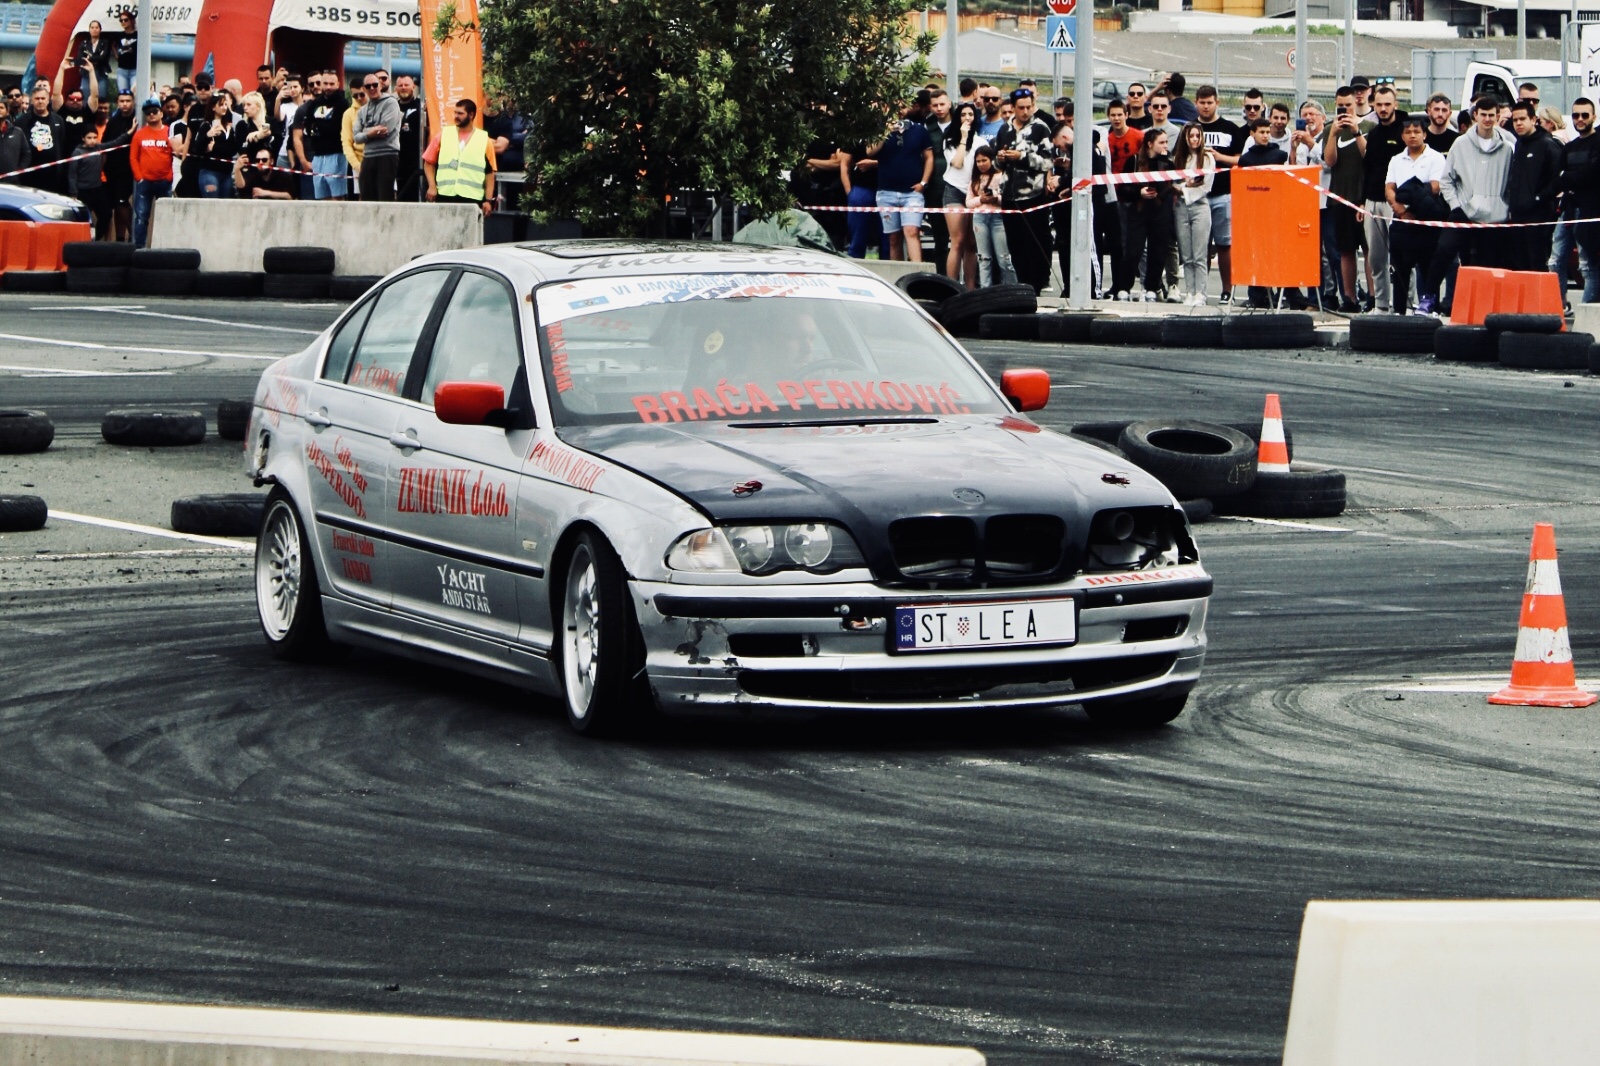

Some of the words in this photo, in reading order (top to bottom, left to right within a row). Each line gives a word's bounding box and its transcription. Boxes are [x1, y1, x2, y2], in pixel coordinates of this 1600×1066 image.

[151, 6, 165, 21] 06
[306, 6, 351, 22] +385
[357, 10, 380, 25] 95
[386, 12, 421, 26] 506
[567, 252, 702, 275] Andi
[718, 252, 840, 271] Star
[631, 378, 780, 423] BRAĆA
[776, 378, 972, 415] PERKOVIĆ
[353, 464, 368, 494] bar
[397, 468, 471, 515] ZEMUNIK
[470, 470, 509, 518] d.o.o.
[437, 563, 486, 594] YACHT
[442, 588, 465, 608] ANDI
[464, 592, 491, 614] STAR
[901, 634, 913, 642] HR
[921, 613, 948, 643] ST
